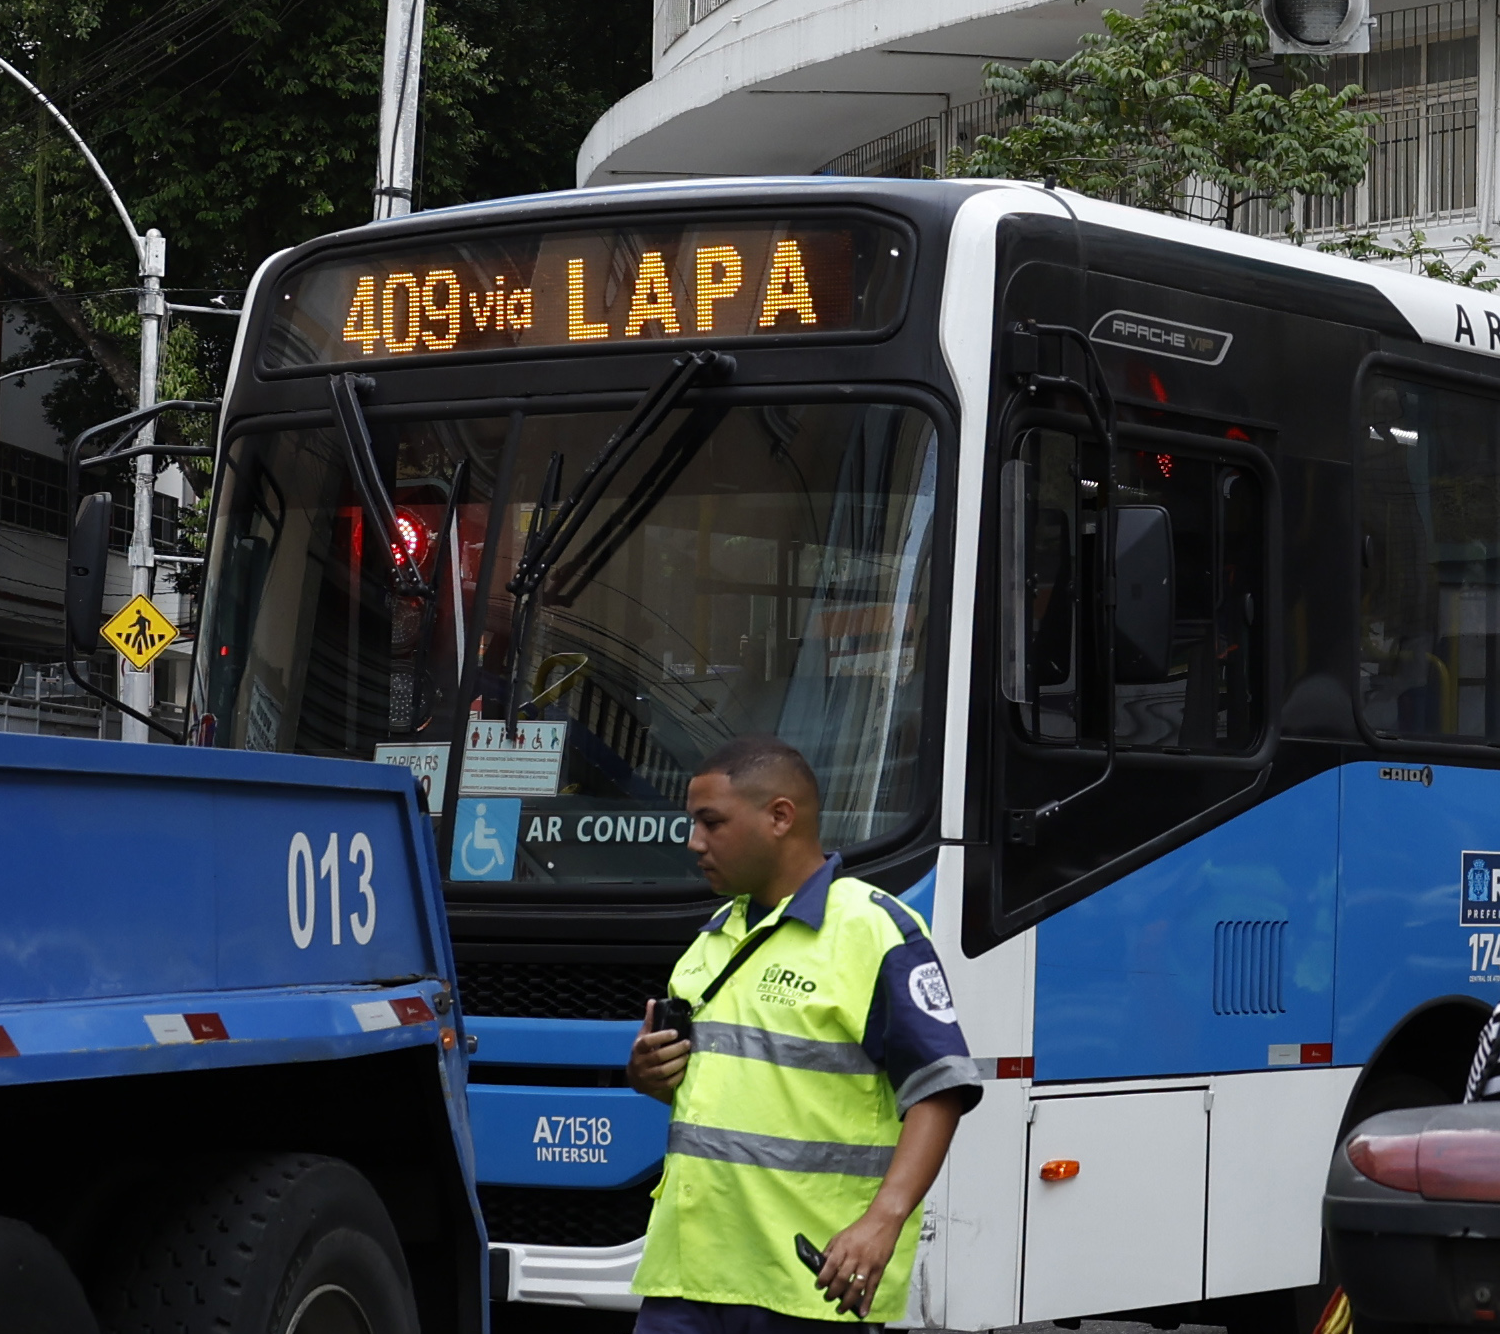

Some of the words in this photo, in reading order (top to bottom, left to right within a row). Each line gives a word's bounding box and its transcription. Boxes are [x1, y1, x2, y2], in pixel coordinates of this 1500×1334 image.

[341, 269, 463, 355] 409
[467, 273, 533, 332] via
[566, 238, 817, 342] LAPA
[1112, 320, 1185, 348] APACHE
[1187, 336, 1215, 352] VIP
[424, 754, 439, 772] R$
[1378, 767, 1421, 782] CAIO
[526, 816, 562, 843] AR
[576, 814, 696, 845] CONDICI
[287, 831, 377, 950] 013
[778, 969, 817, 993] Rio
[760, 993, 797, 1007] CET-RIO
[532, 1115, 612, 1146] A71518
[536, 1146, 608, 1163] INTERSUL
